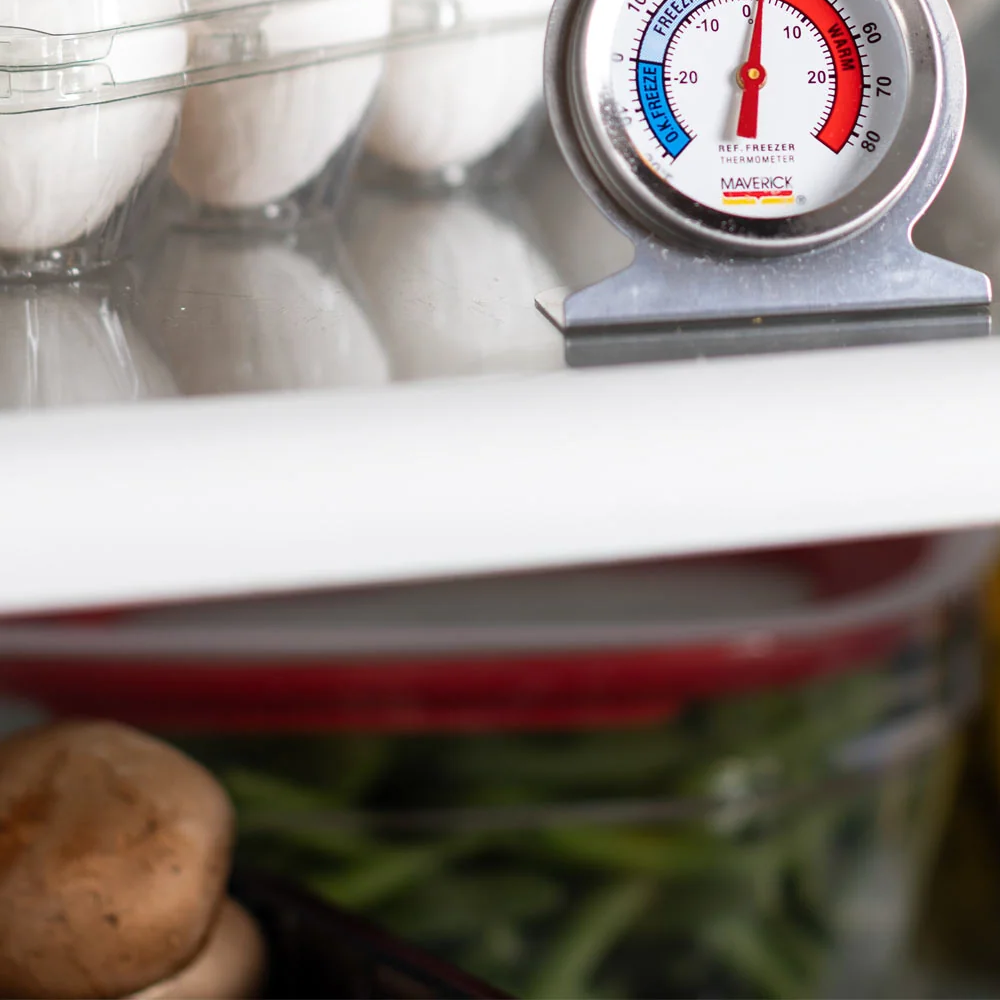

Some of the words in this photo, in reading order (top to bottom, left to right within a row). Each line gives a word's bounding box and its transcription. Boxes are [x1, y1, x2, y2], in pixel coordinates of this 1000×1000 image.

[695, 18, 719, 32] -10
[783, 25, 802, 39] 10
[862, 22, 882, 44] 60
[827, 23, 855, 71] WARM
[673, 70, 698, 84] -20
[807, 70, 826, 84] 20
[876, 76, 892, 97] 70
[745, 143, 795, 152] FREEZER
[861, 130, 881, 152] 80
[720, 155, 795, 164] THERMOMETER
[720, 176, 793, 190] MAVERICK
